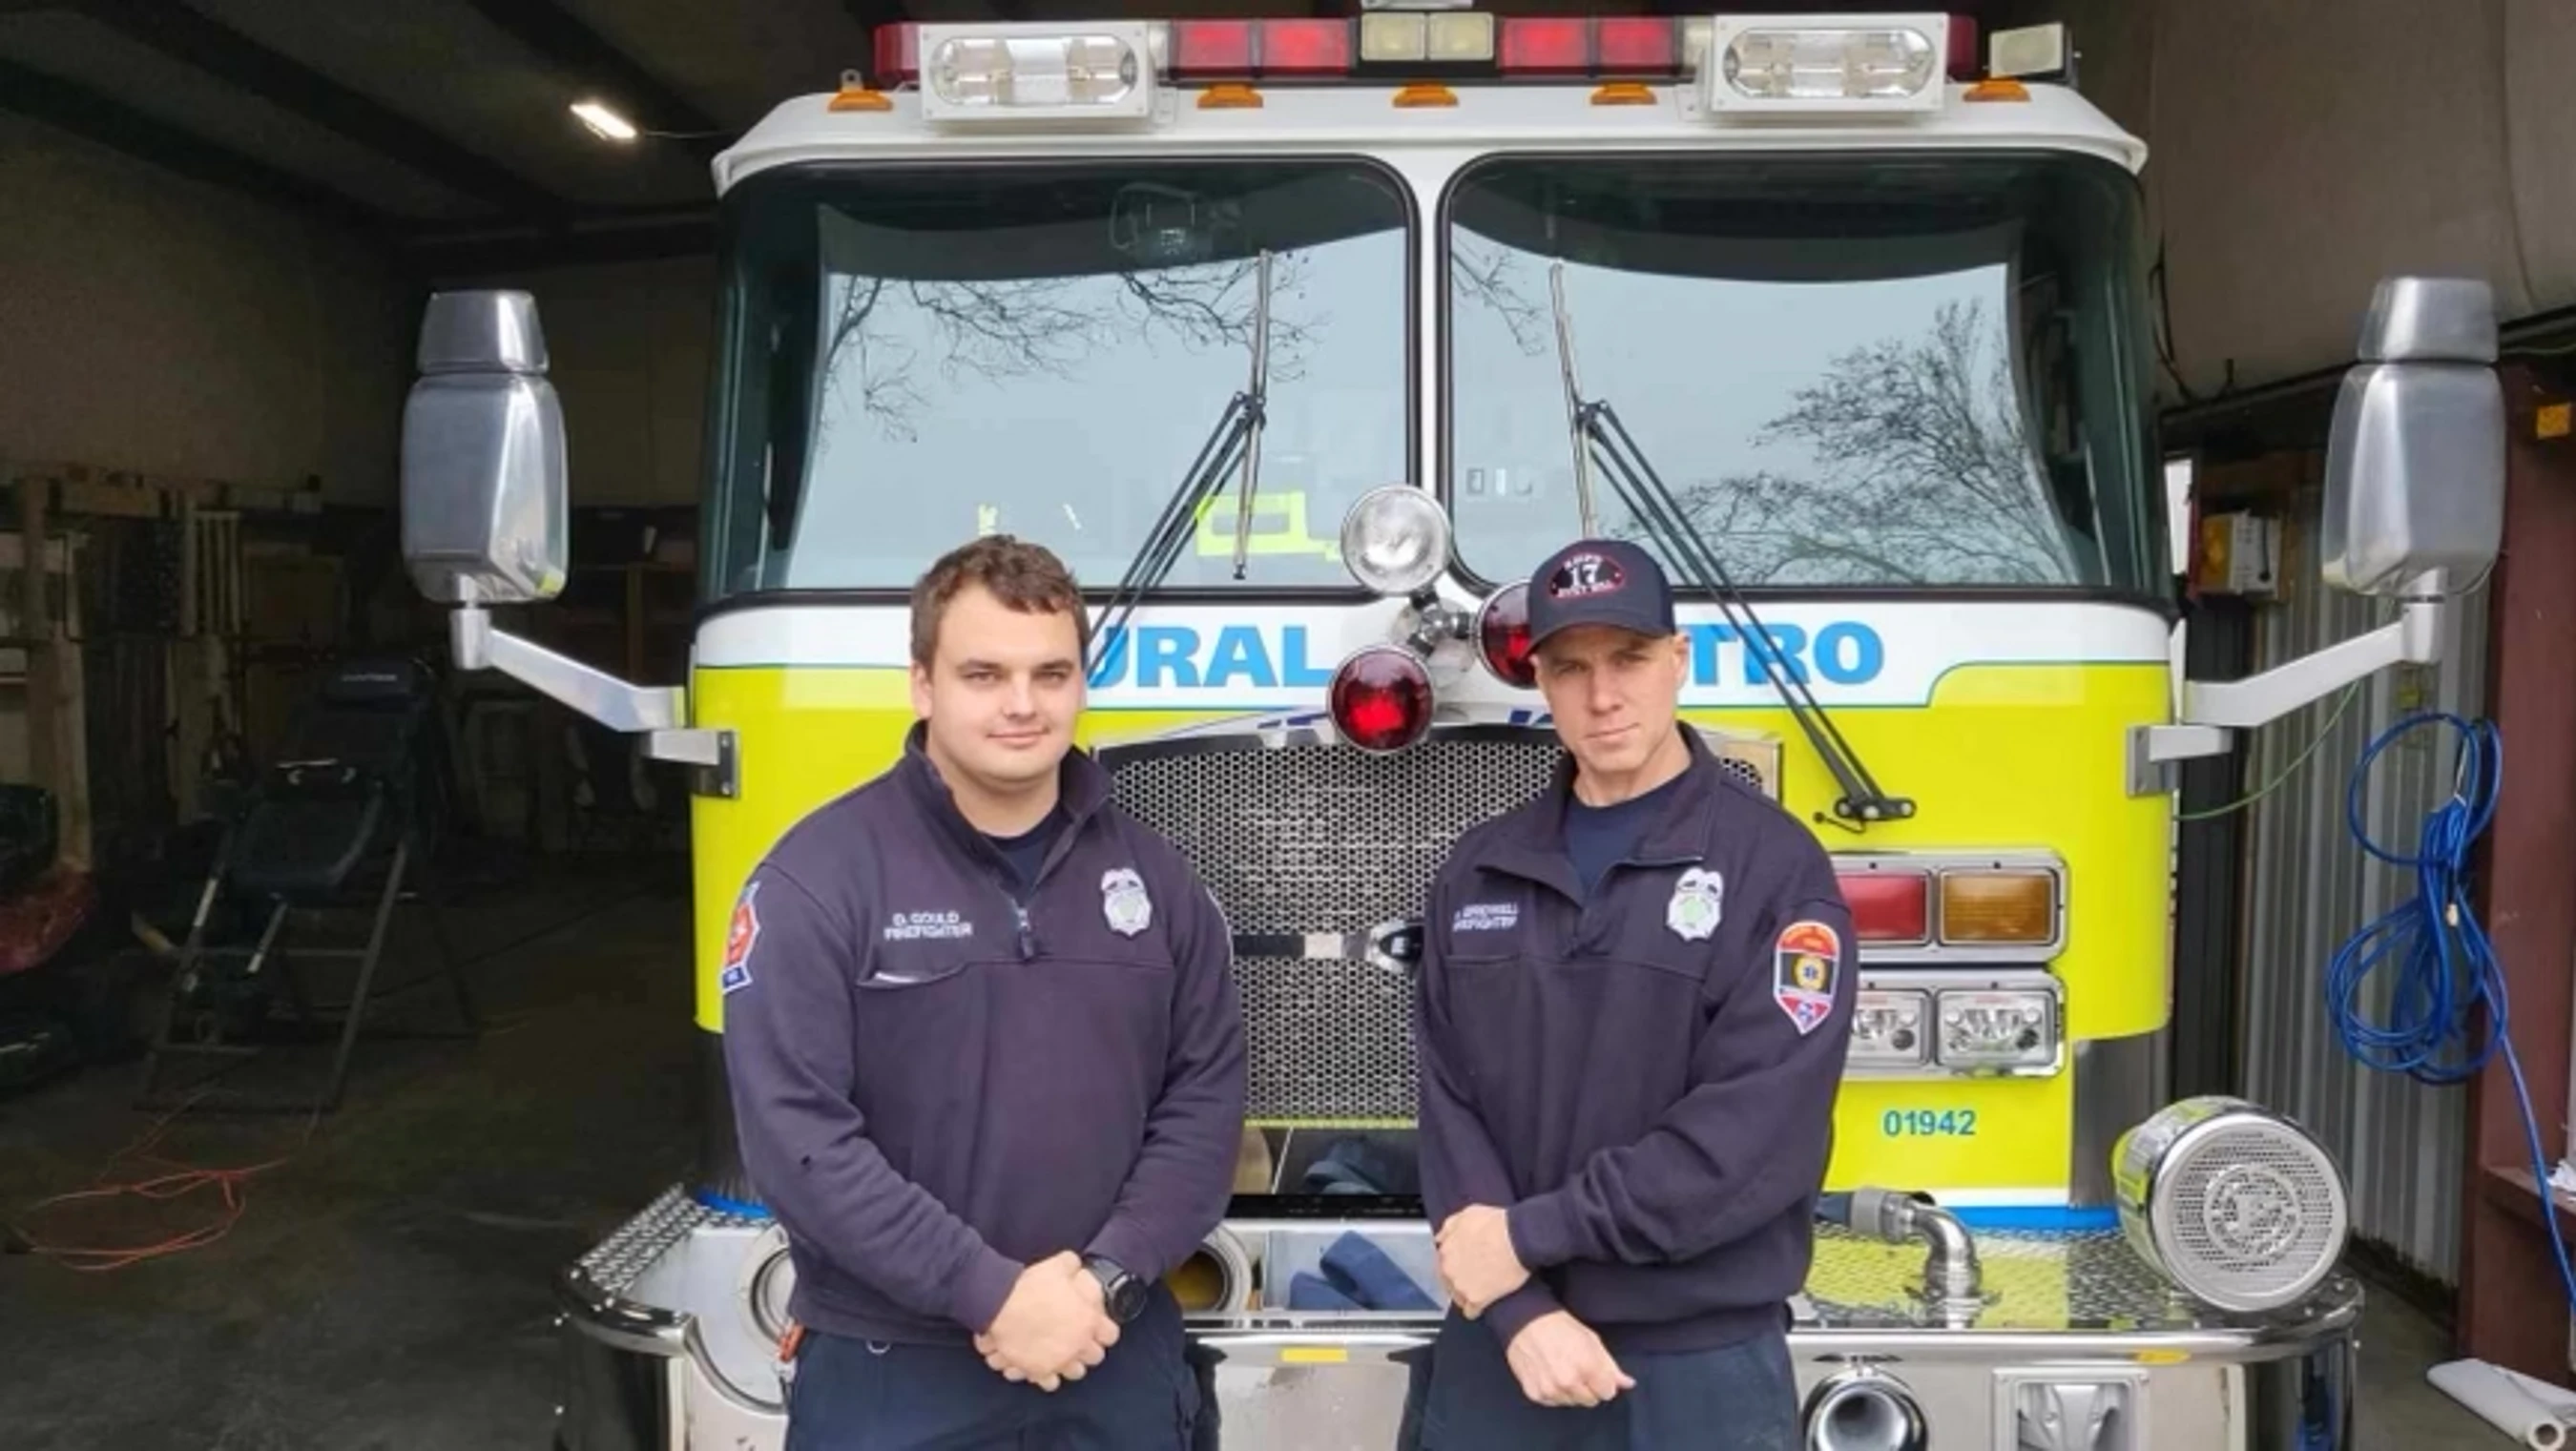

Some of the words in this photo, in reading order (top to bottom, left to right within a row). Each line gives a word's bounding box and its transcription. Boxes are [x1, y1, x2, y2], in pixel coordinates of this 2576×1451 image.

[1568, 563, 1598, 586] 17
[1086, 626, 1334, 688] URAL
[1678, 621, 1884, 686] TRO
[910, 910, 960, 924] GOULD
[1883, 1109, 1976, 1137] 01942
